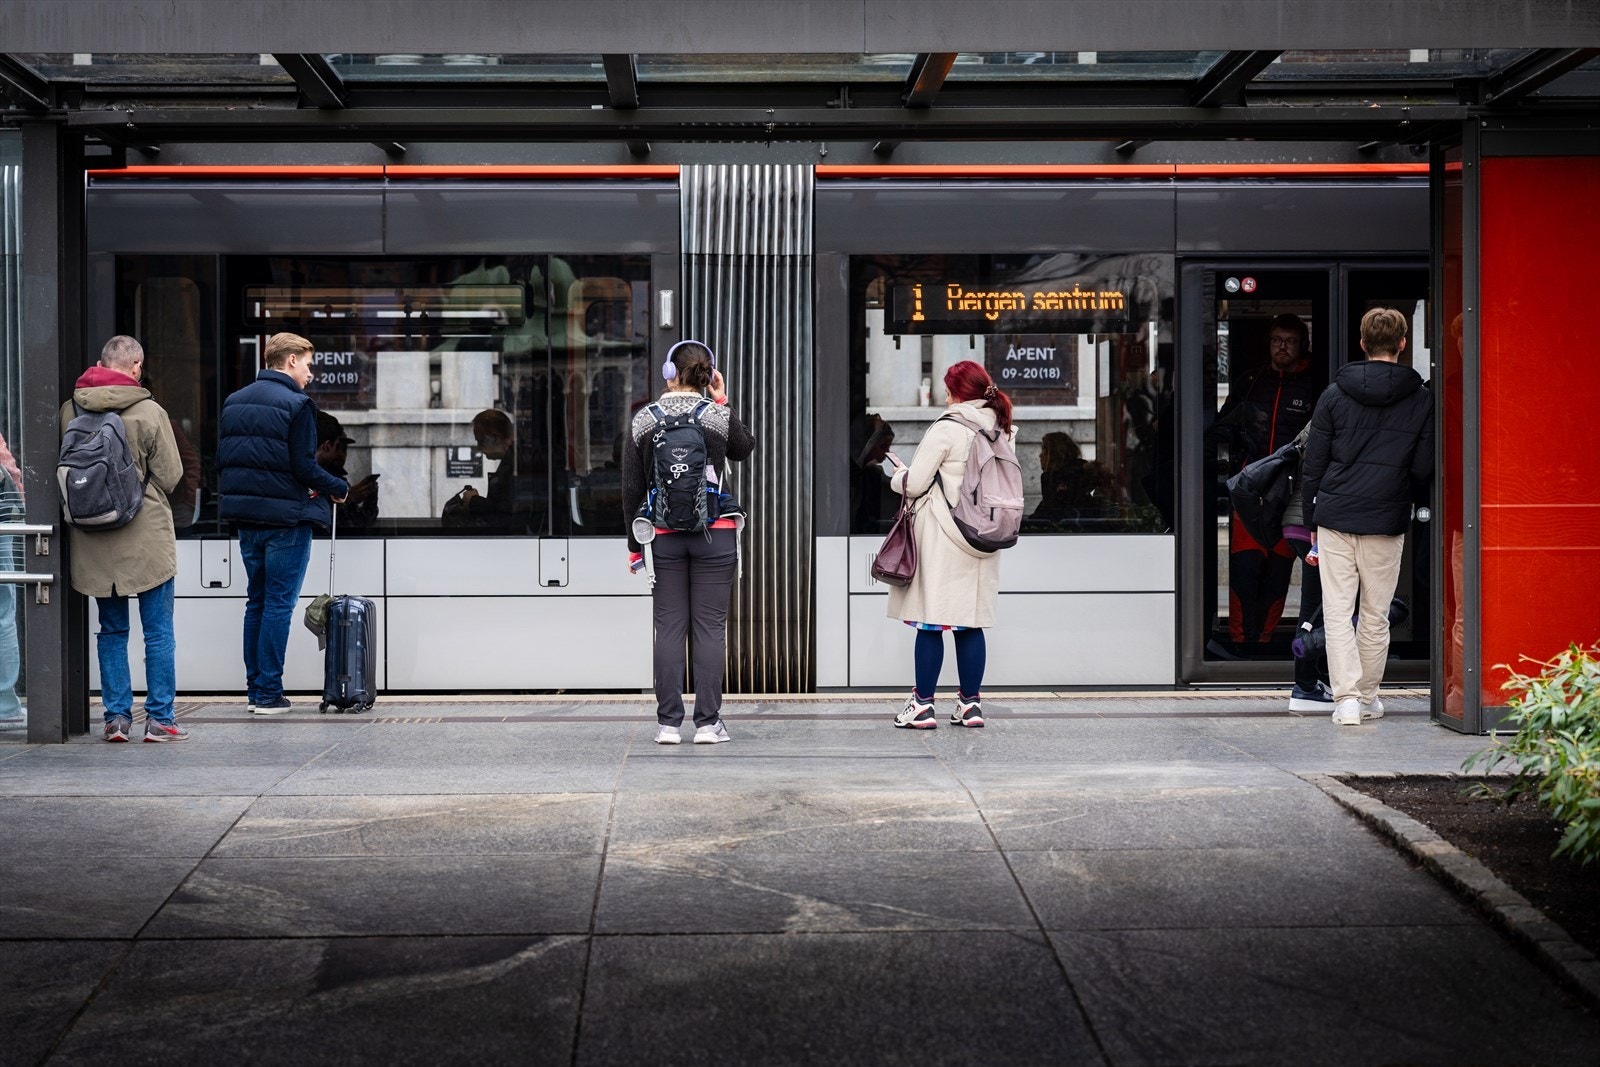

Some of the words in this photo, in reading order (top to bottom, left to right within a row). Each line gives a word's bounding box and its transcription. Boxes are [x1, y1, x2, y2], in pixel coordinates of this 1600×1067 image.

[912, 284, 925, 321] 1
[947, 284, 1025, 320] Bergen
[1033, 284, 1124, 310] sentrum
[1006, 344, 1056, 361] ÅPENT
